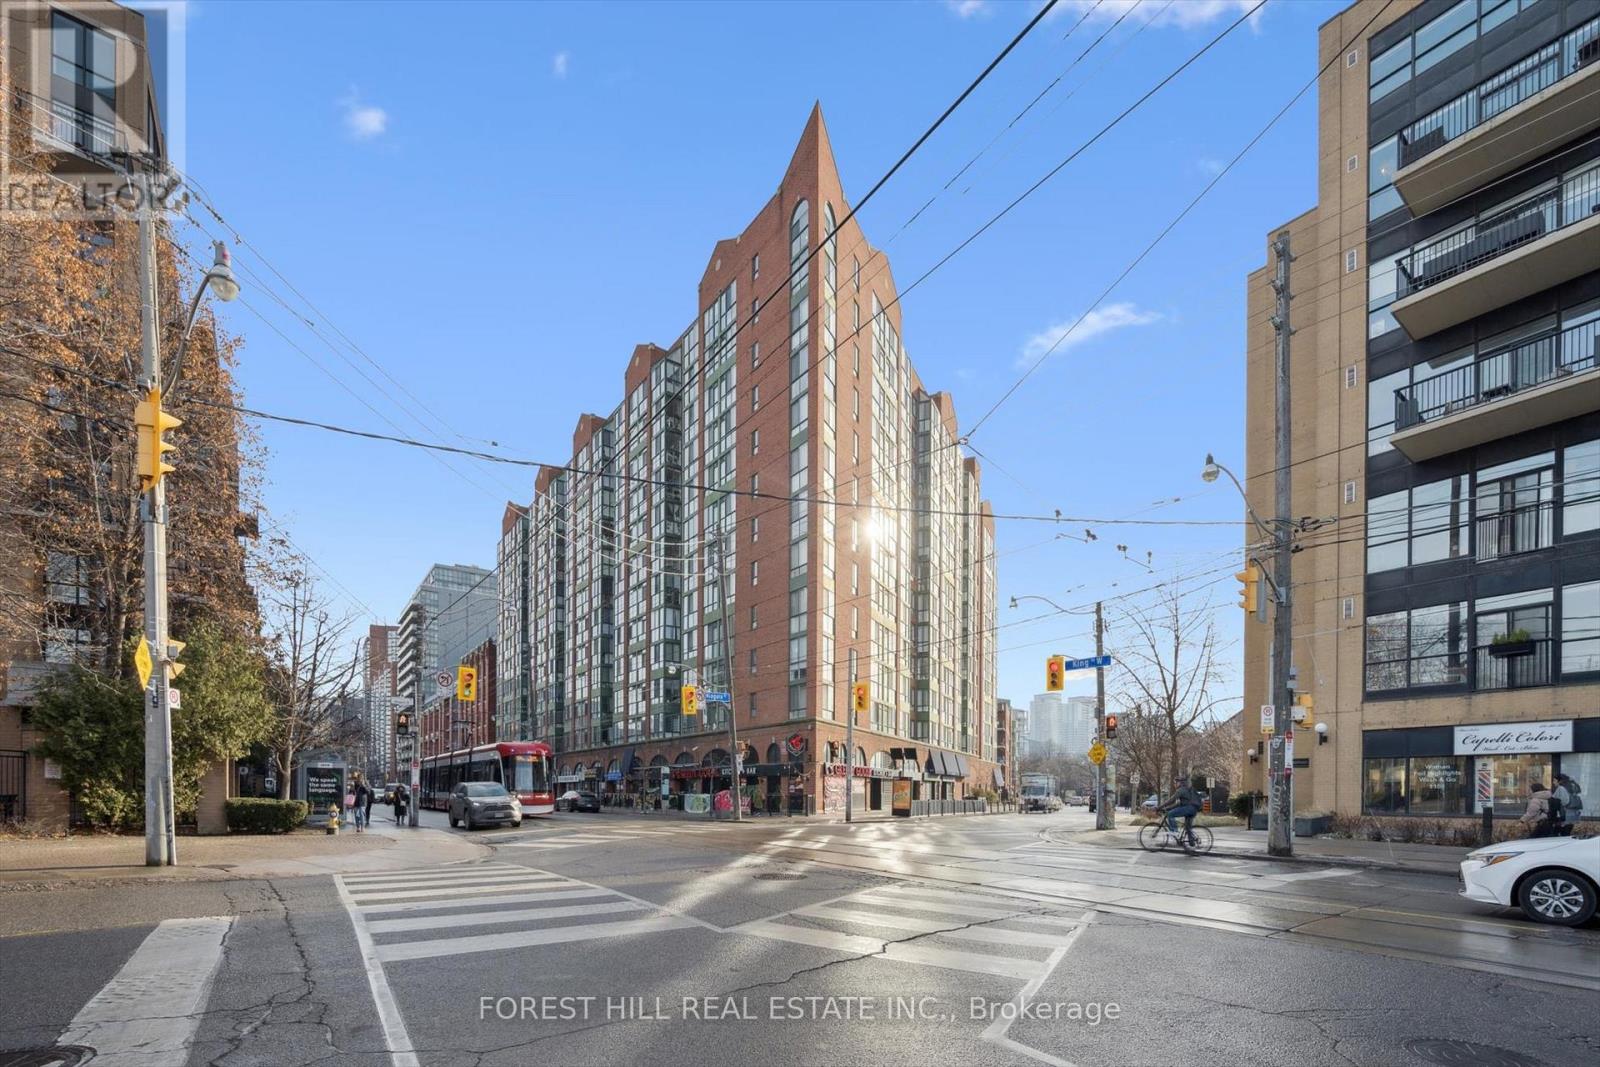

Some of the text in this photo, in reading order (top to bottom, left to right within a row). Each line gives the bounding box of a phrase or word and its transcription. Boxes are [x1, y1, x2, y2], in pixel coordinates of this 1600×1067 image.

[1072, 659, 1089, 669] King
[1096, 656, 1103, 665] W
[1462, 730, 1562, 752] Capelli Colori
[746, 767, 757, 775] BAR
